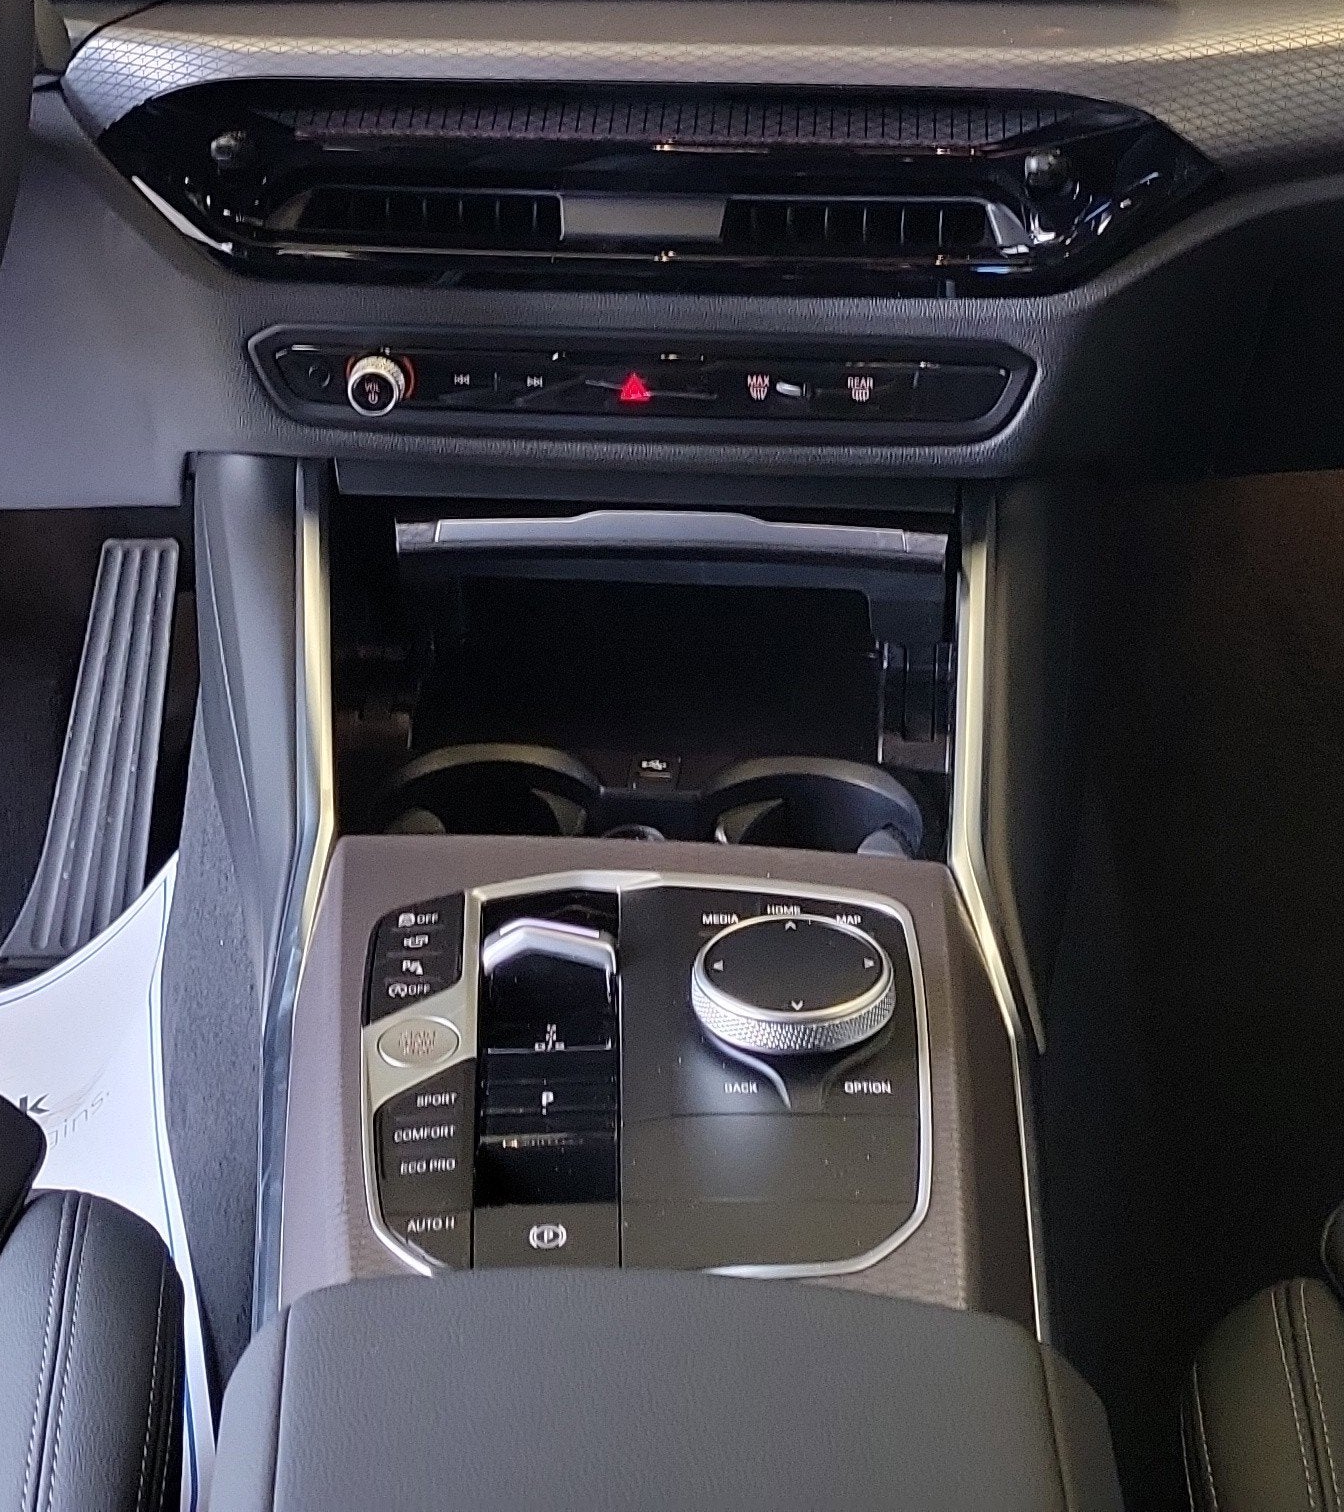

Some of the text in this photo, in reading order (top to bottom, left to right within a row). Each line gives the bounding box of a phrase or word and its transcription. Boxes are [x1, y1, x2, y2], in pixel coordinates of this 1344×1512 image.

[416, 912, 439, 925] OFF
[702, 912, 739, 925] MEDIA
[408, 983, 431, 996] OFF
[844, 1079, 893, 1095] OPTION
[416, 1091, 457, 1108] SPORT
[394, 1123, 456, 1143] COMFORT
[407, 1216, 443, 1233] AUTO
